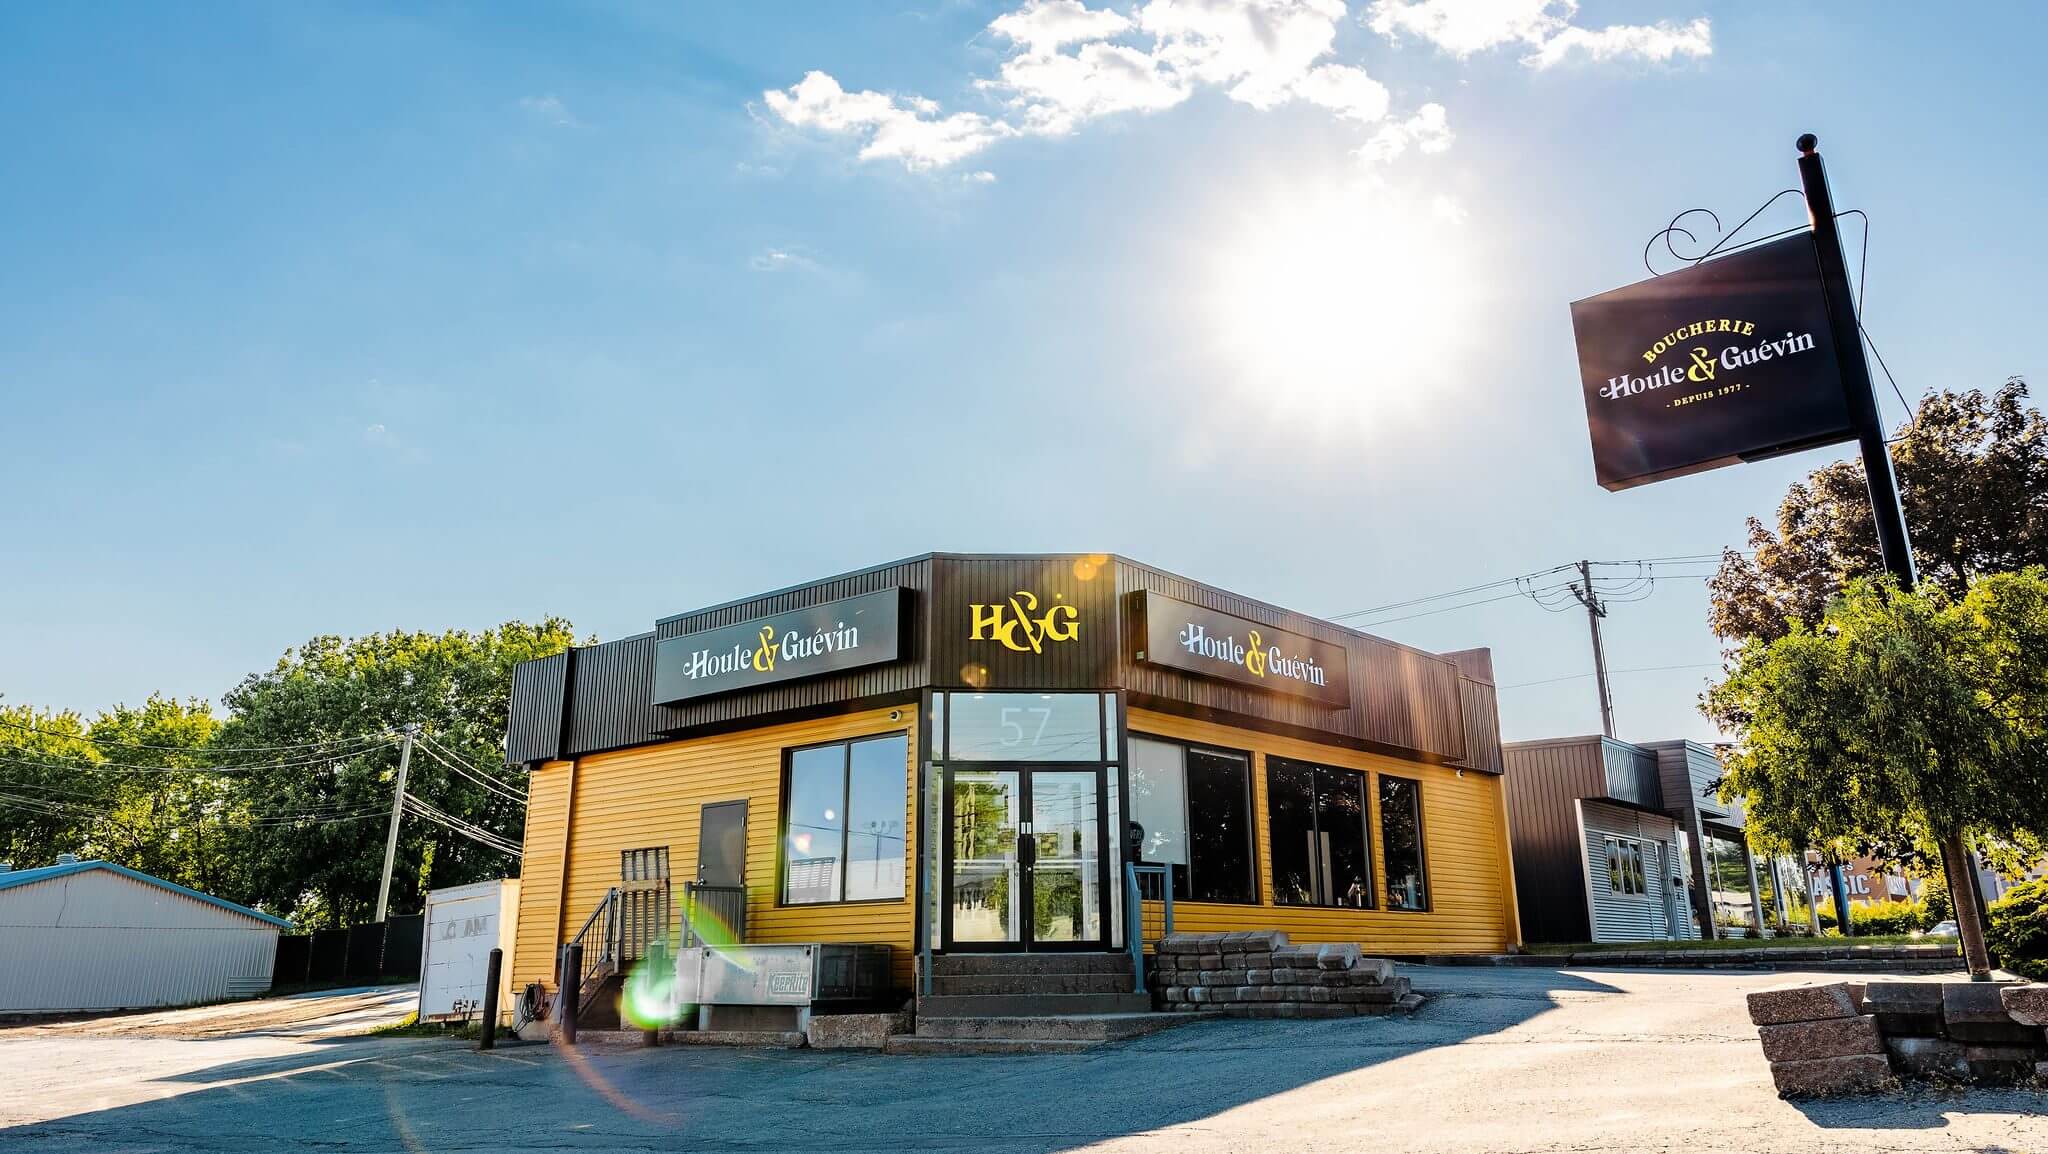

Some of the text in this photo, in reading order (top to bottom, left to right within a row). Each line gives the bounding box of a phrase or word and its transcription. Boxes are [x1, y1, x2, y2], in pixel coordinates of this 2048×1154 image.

[1599, 331, 1816, 400] Houle & Guévin
[1642, 319, 1755, 364] BOUCHERIE
[1673, 383, 1741, 407] DEPUIS 1977
[682, 620, 858, 681] Houle & Guévin
[1179, 622, 1326, 687] Houle & Guévin
[1000, 708, 1051, 747] 57
